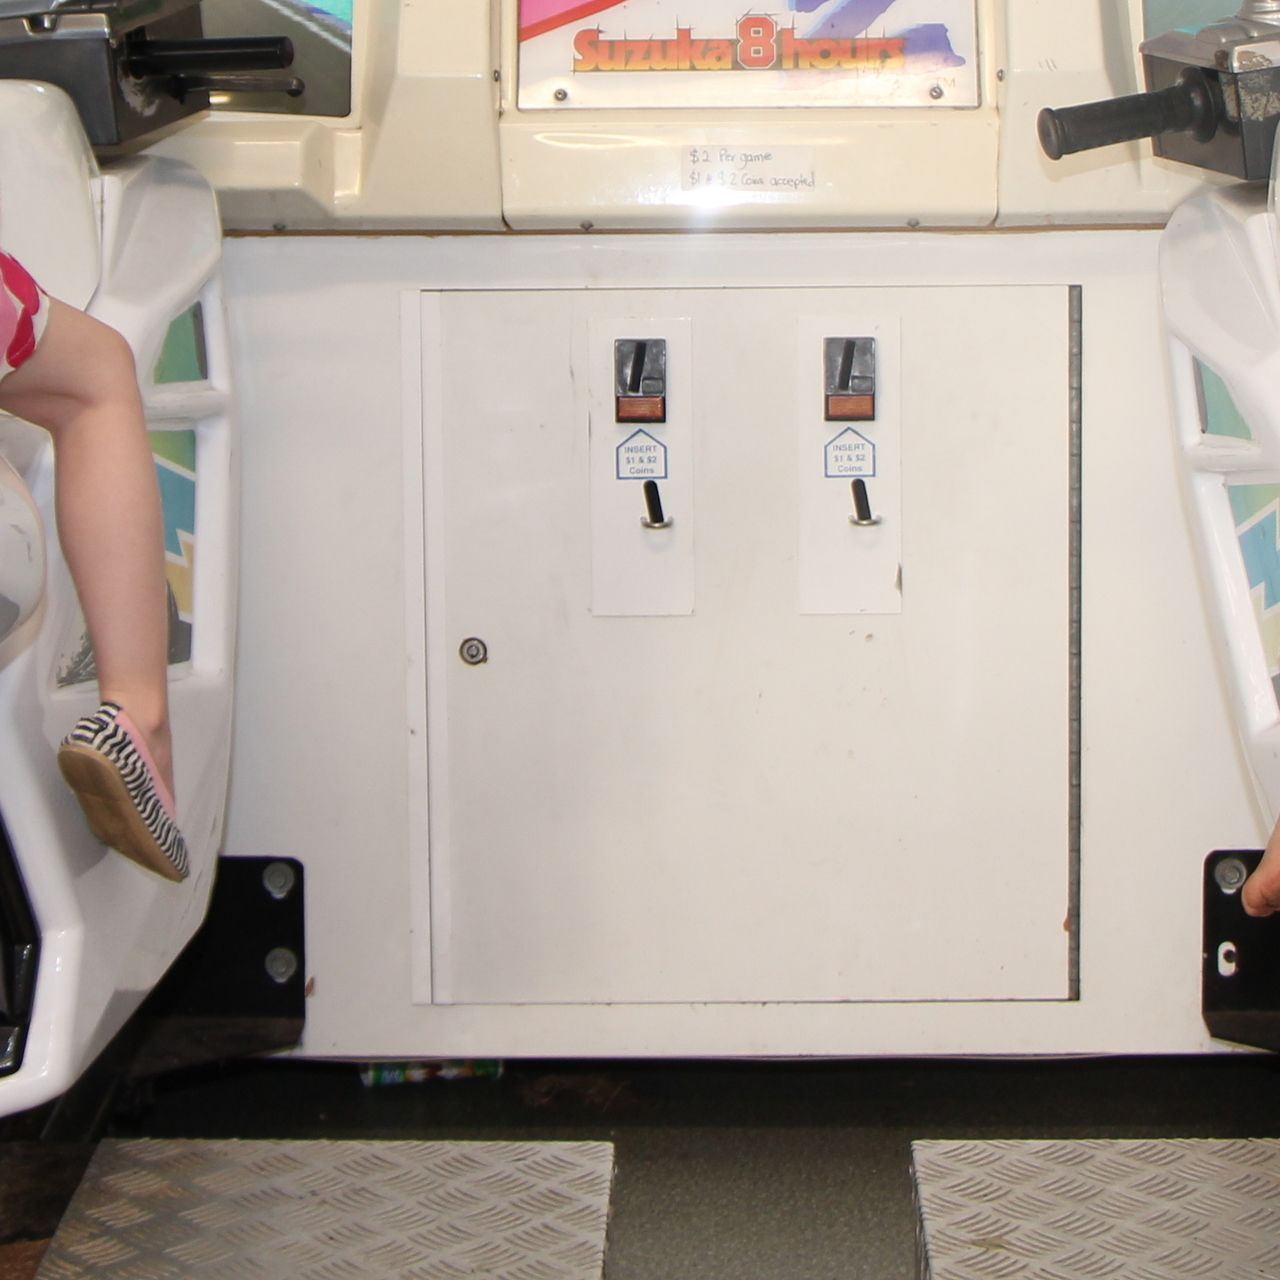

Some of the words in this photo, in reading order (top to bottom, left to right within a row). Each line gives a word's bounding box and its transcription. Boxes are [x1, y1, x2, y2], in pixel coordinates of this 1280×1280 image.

[574, 27, 733, 71] Suzuka
[736, 14, 777, 70] 8
[779, 27, 906, 70] hours
[740, 151, 773, 169] game
[770, 171, 816, 190] accepted
[624, 445, 657, 454] INSERT
[832, 443, 865, 451] INSERT
[629, 467, 655, 475] Coins
